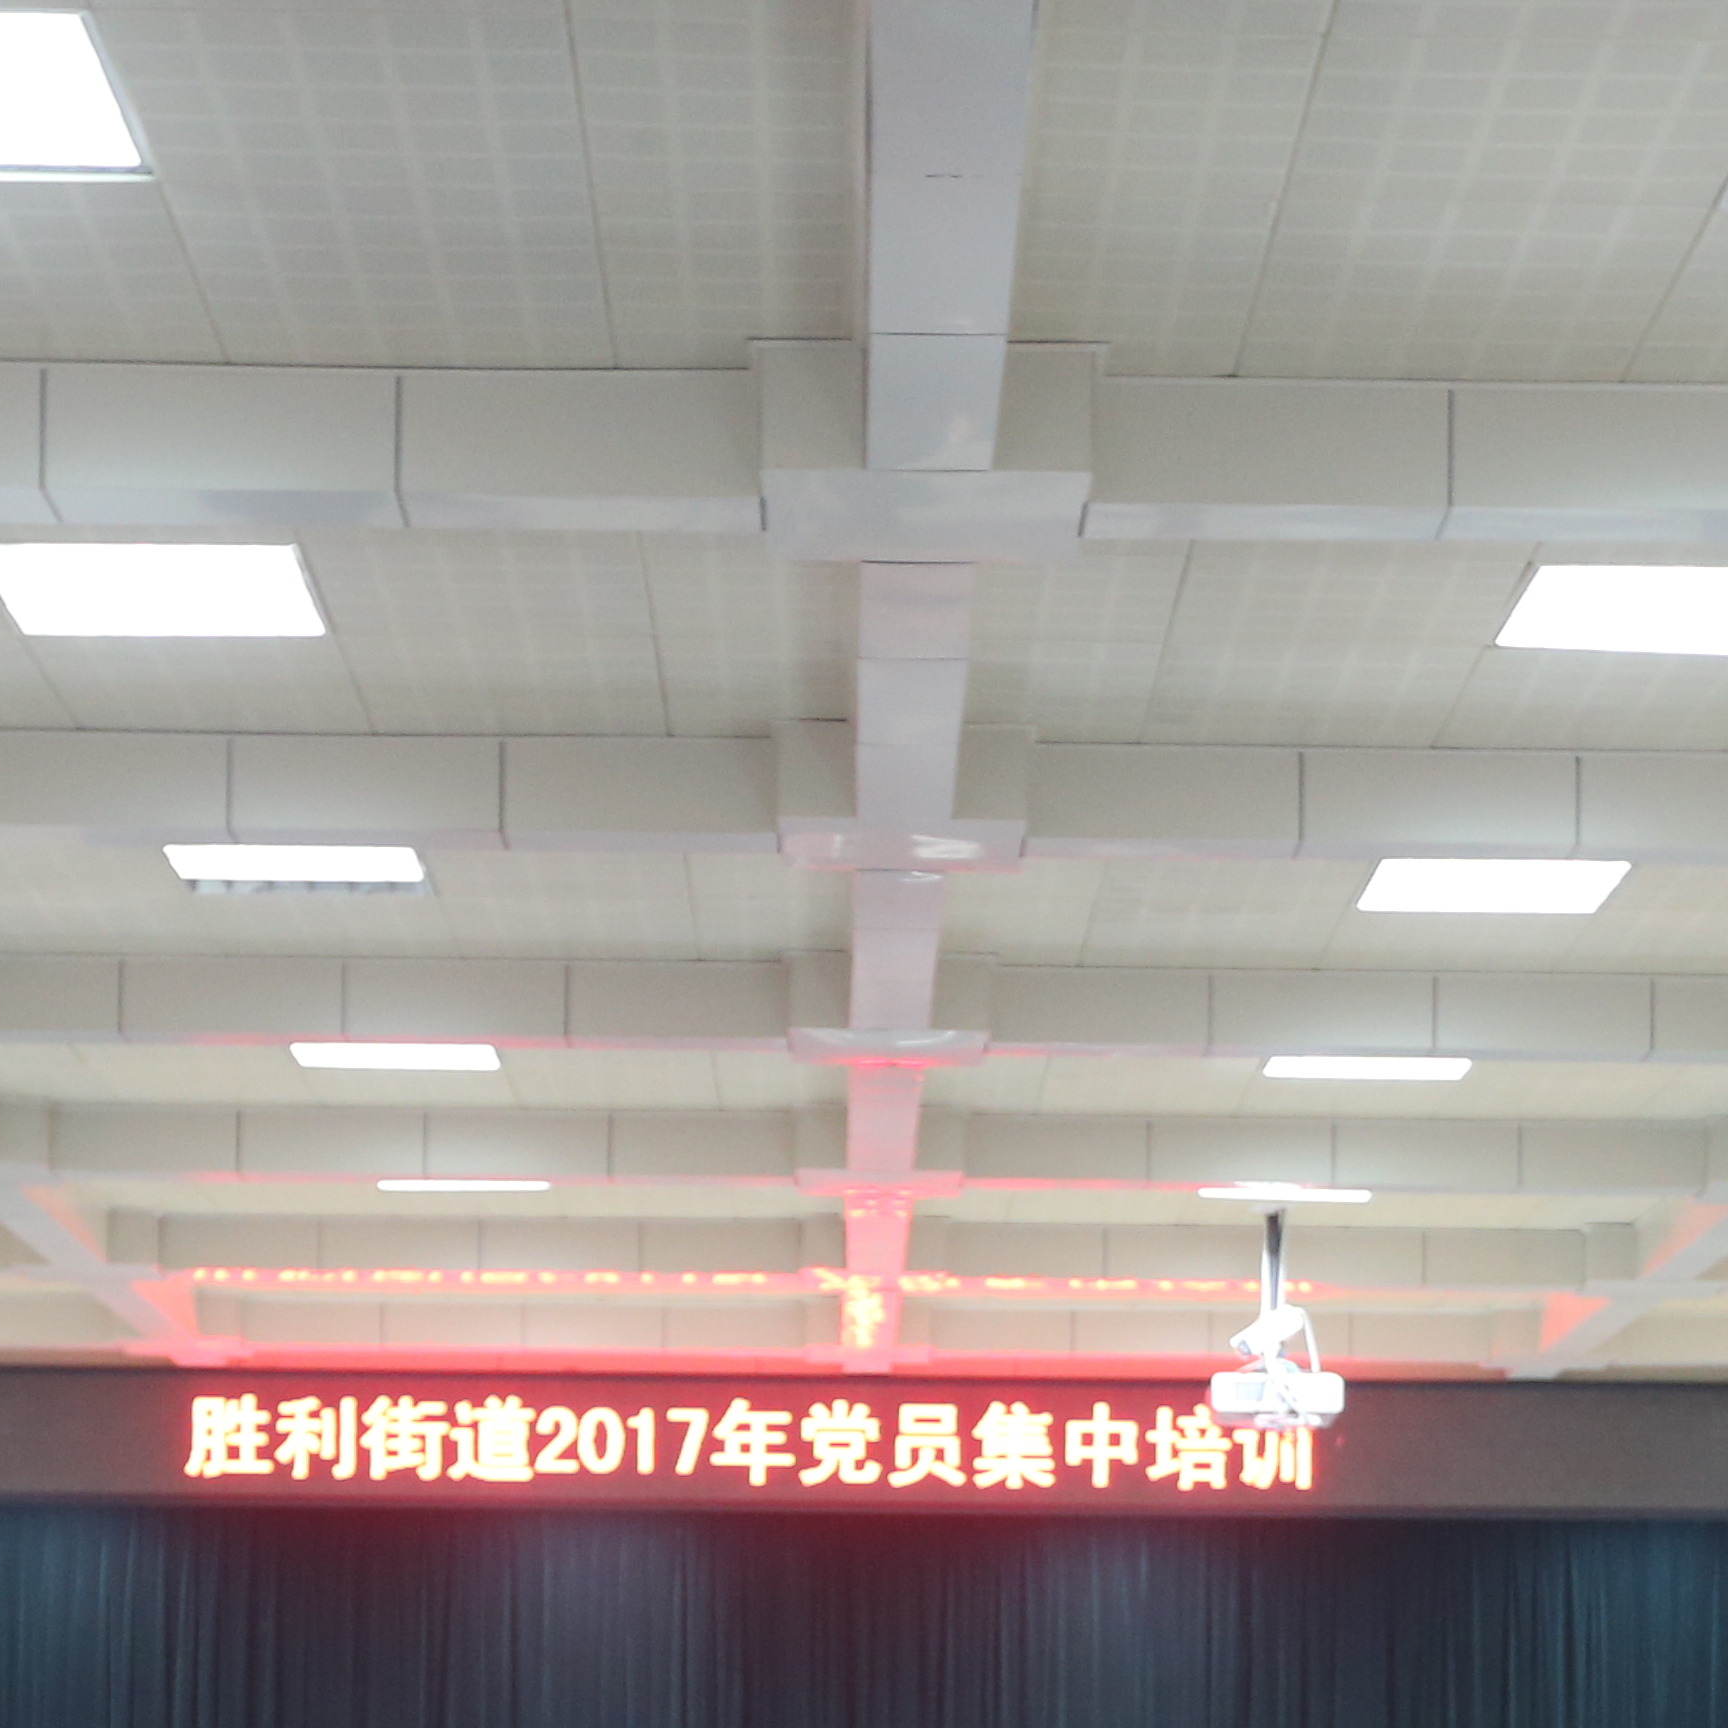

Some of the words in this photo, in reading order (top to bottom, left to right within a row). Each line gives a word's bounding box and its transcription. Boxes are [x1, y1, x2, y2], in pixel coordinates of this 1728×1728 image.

[184, 1394, 1313, 1491] 胜利街道2017年党员集中培训
